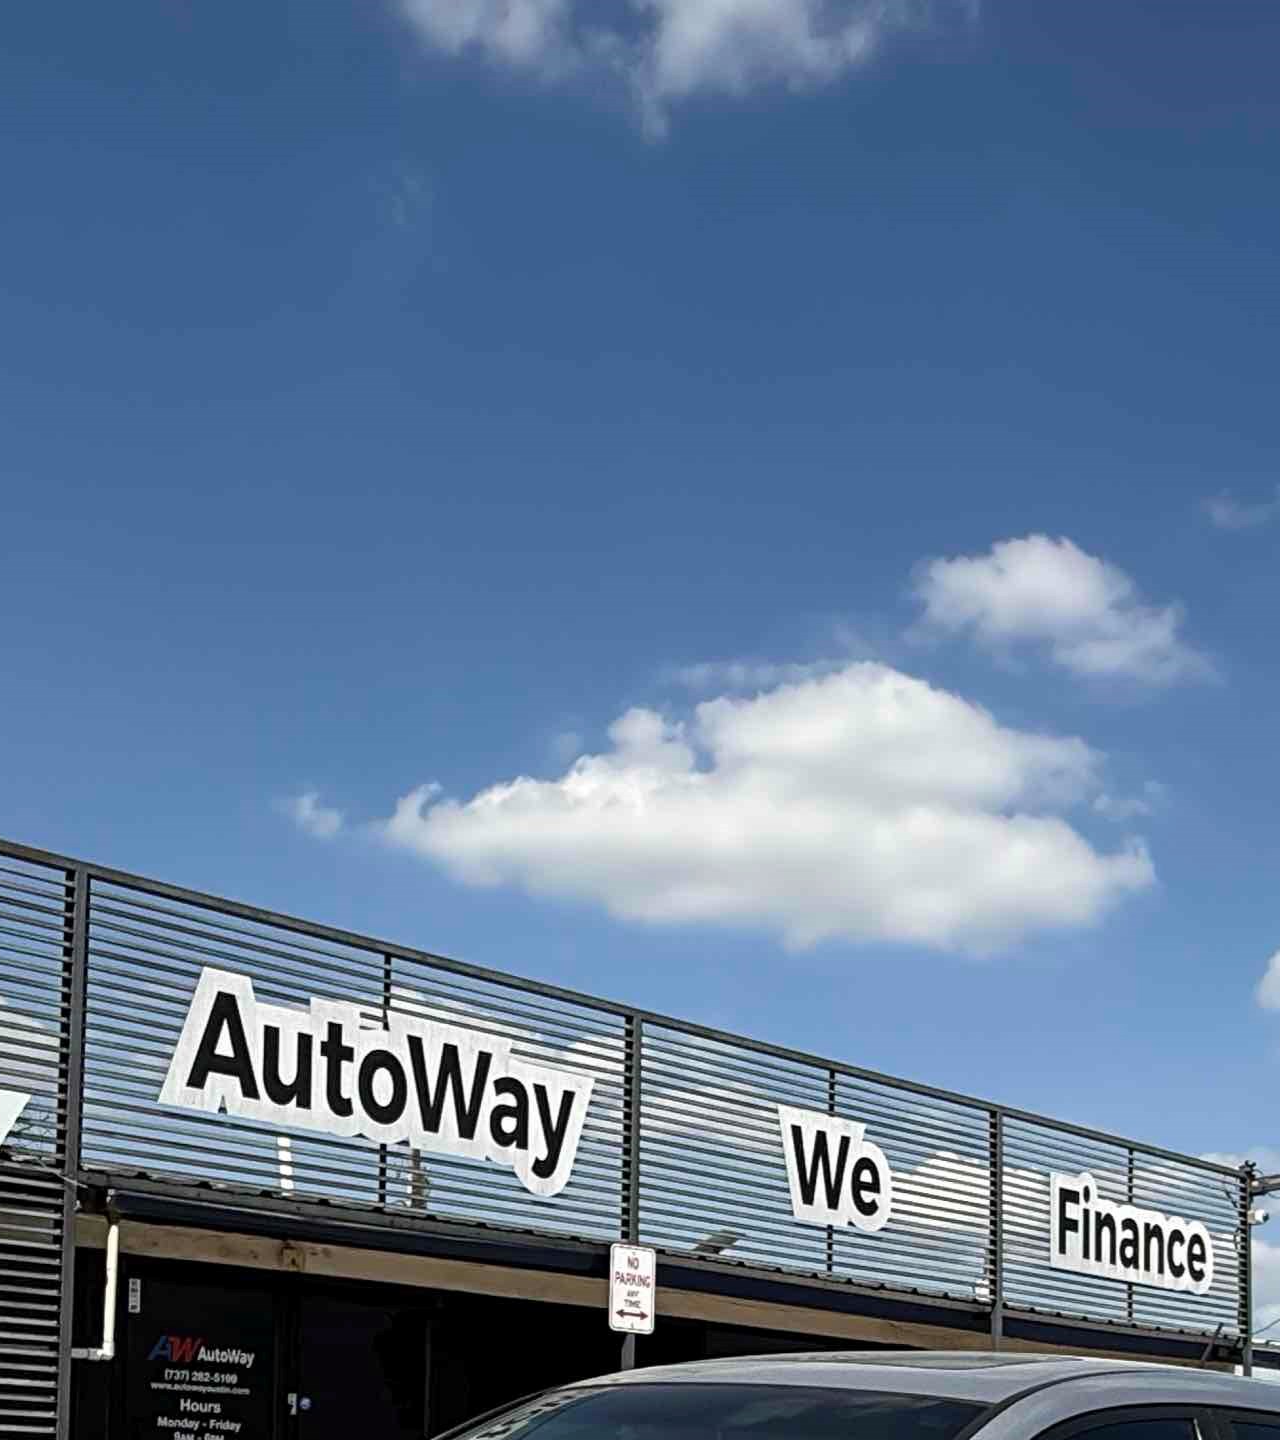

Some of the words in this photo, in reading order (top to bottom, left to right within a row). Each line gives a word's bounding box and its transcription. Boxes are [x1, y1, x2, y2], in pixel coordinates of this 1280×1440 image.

[186, 991, 576, 1179] AutoWay
[791, 1125, 881, 1216] We
[1058, 1185, 1206, 1282] Finance
[627, 1256, 640, 1270] NO
[615, 1271, 651, 1288] PARKING
[624, 1298, 641, 1309] TIME
[197, 1347, 255, 1368] AutoWay
[164, 1368, 189, 1382] (737)
[180, 1398, 222, 1414] Hours
[157, 1416, 200, 1431] Monday
[209, 1419, 241, 1432] Friday
